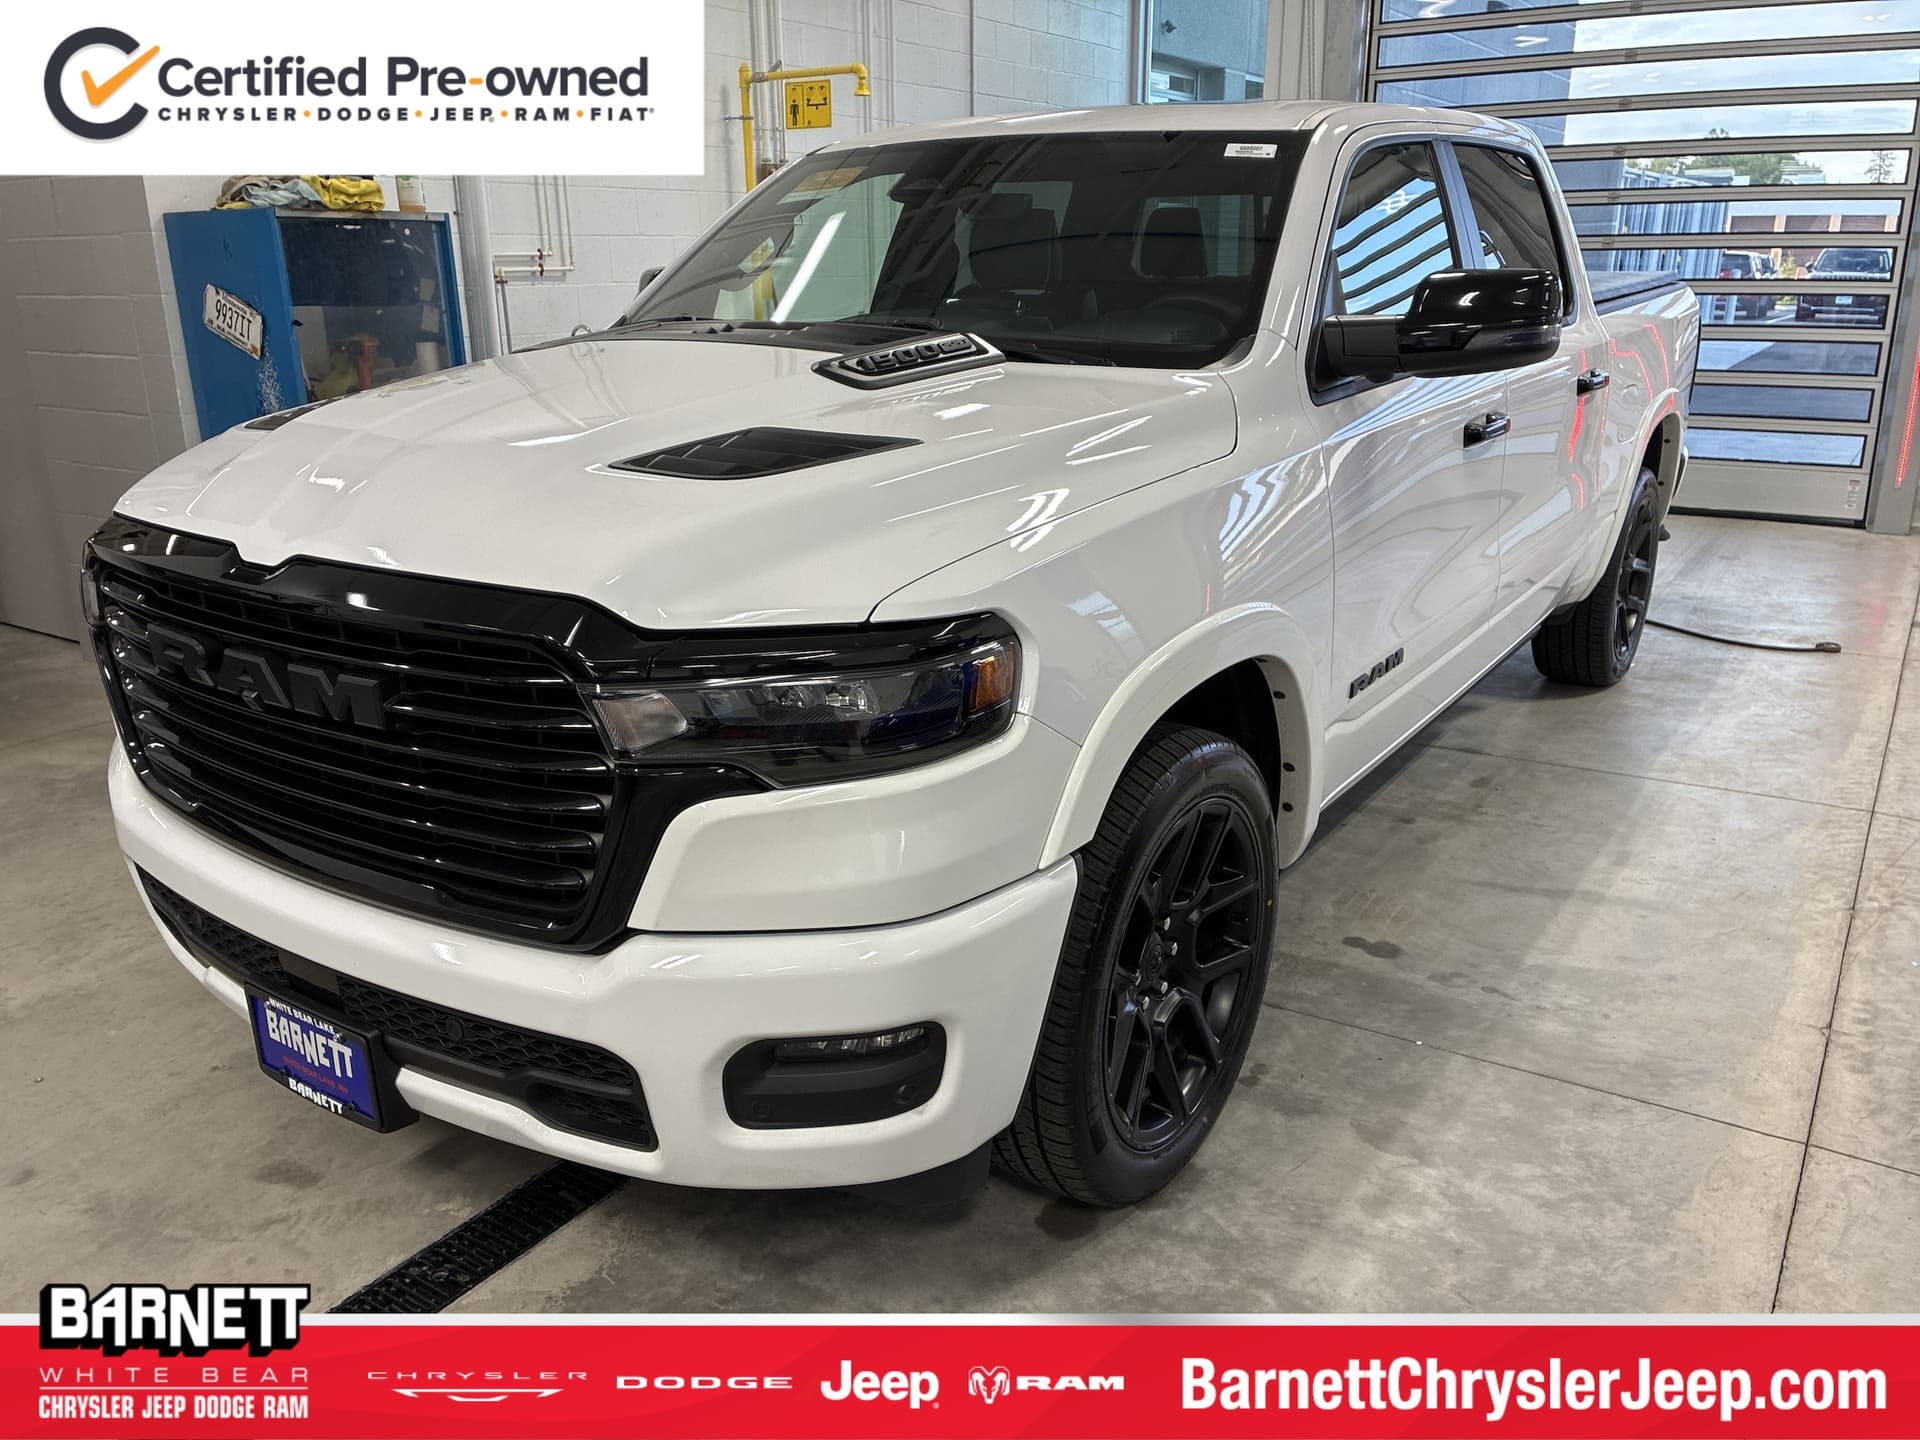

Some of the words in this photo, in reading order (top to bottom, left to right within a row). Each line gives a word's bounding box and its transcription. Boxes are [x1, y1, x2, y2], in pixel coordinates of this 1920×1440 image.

[215, 298, 253, 341] 9937IT
[856, 341, 941, 372] 1500
[147, 622, 386, 730] RAM
[1348, 647, 1404, 700] RAM
[265, 1008, 353, 1079] BARNETT
[313, 1018, 335, 1034] LAKE
[288, 1077, 343, 1115] BARNETT
